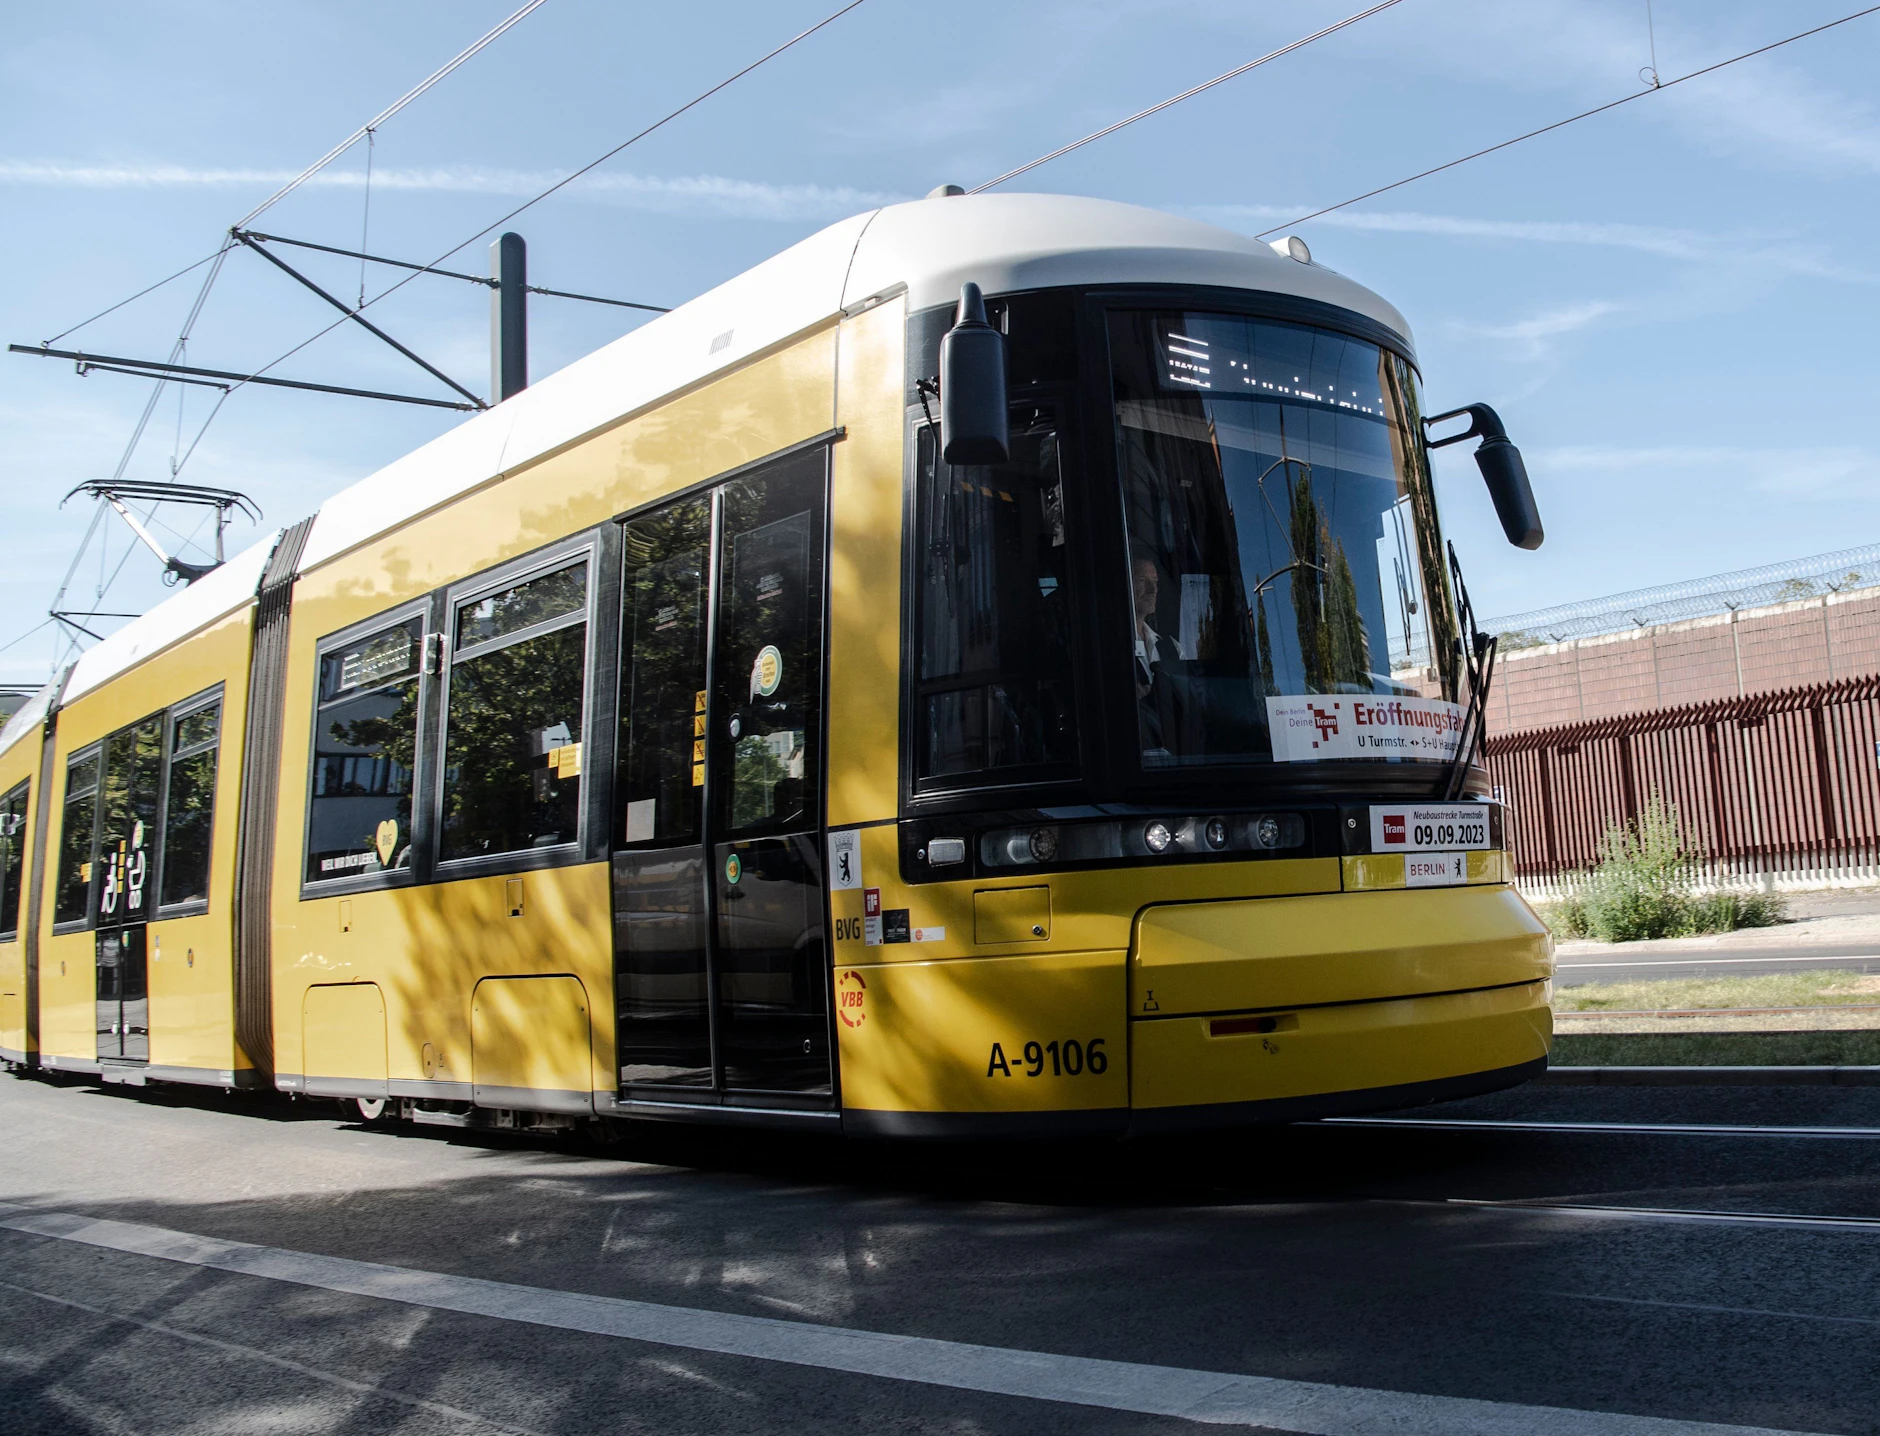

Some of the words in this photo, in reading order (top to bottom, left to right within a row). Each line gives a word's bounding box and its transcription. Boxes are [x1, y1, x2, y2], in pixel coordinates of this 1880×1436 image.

[1289, 718, 1313, 727] Deine
[1315, 717, 1337, 726] Tram
[1353, 702, 1472, 735] Eröffnungsfah
[1358, 736, 1365, 747] U
[1368, 736, 1407, 747] Turmstr.
[1422, 737, 1437, 749] S+U
[1414, 810, 1457, 820] Neubaustrecke
[1458, 810, 1484, 820] Turmstraße
[1384, 823, 1405, 834] Tram
[1414, 824, 1484, 845] 09.09.2023
[1410, 863, 1445, 876] BERLIN
[836, 917, 860, 940] BVG
[841, 991, 863, 1007] VBB
[987, 1038, 1108, 1077] A-9106
